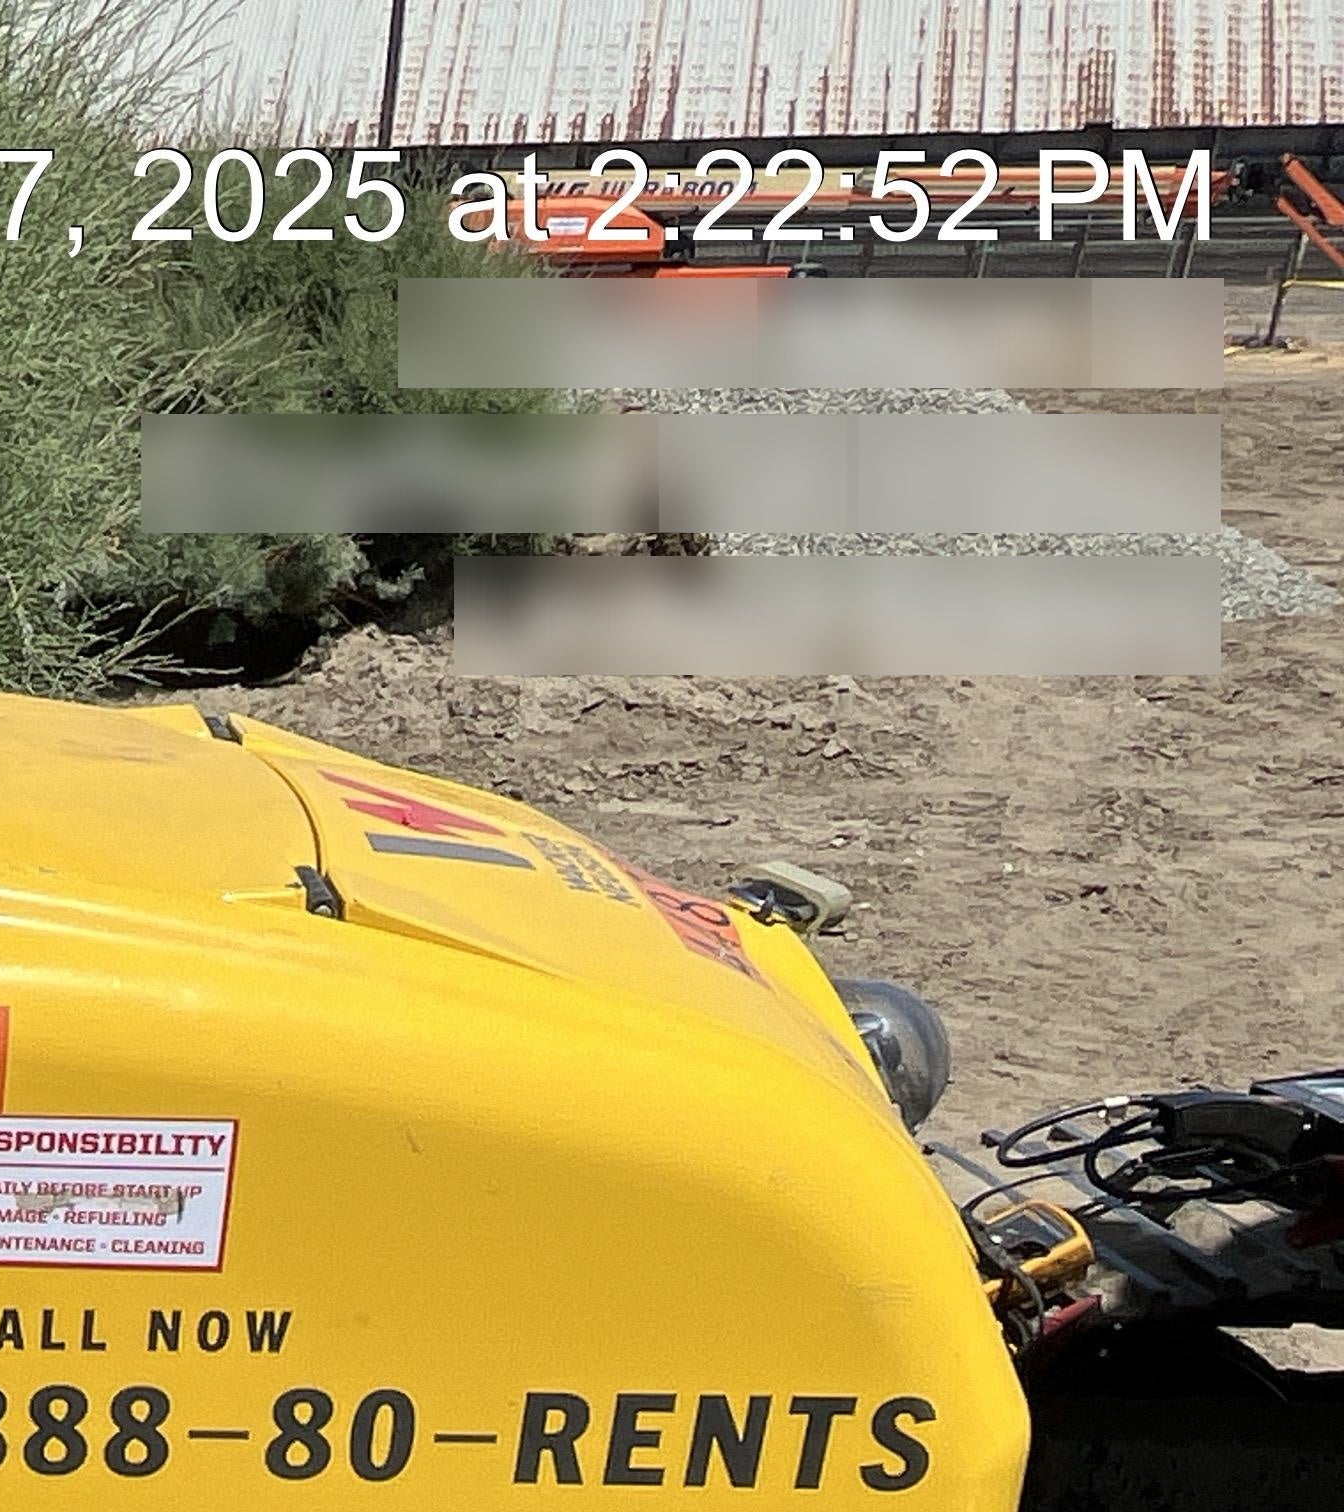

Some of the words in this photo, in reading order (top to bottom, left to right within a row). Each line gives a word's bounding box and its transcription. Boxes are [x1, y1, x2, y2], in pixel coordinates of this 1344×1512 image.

[36, 1181, 110, 1198] BEFORE
[111, 1183, 172, 1199] START
[63, 1208, 168, 1227] REFUELING
[111, 1238, 205, 1255] CLEANING
[146, 1310, 295, 1354] NOW
